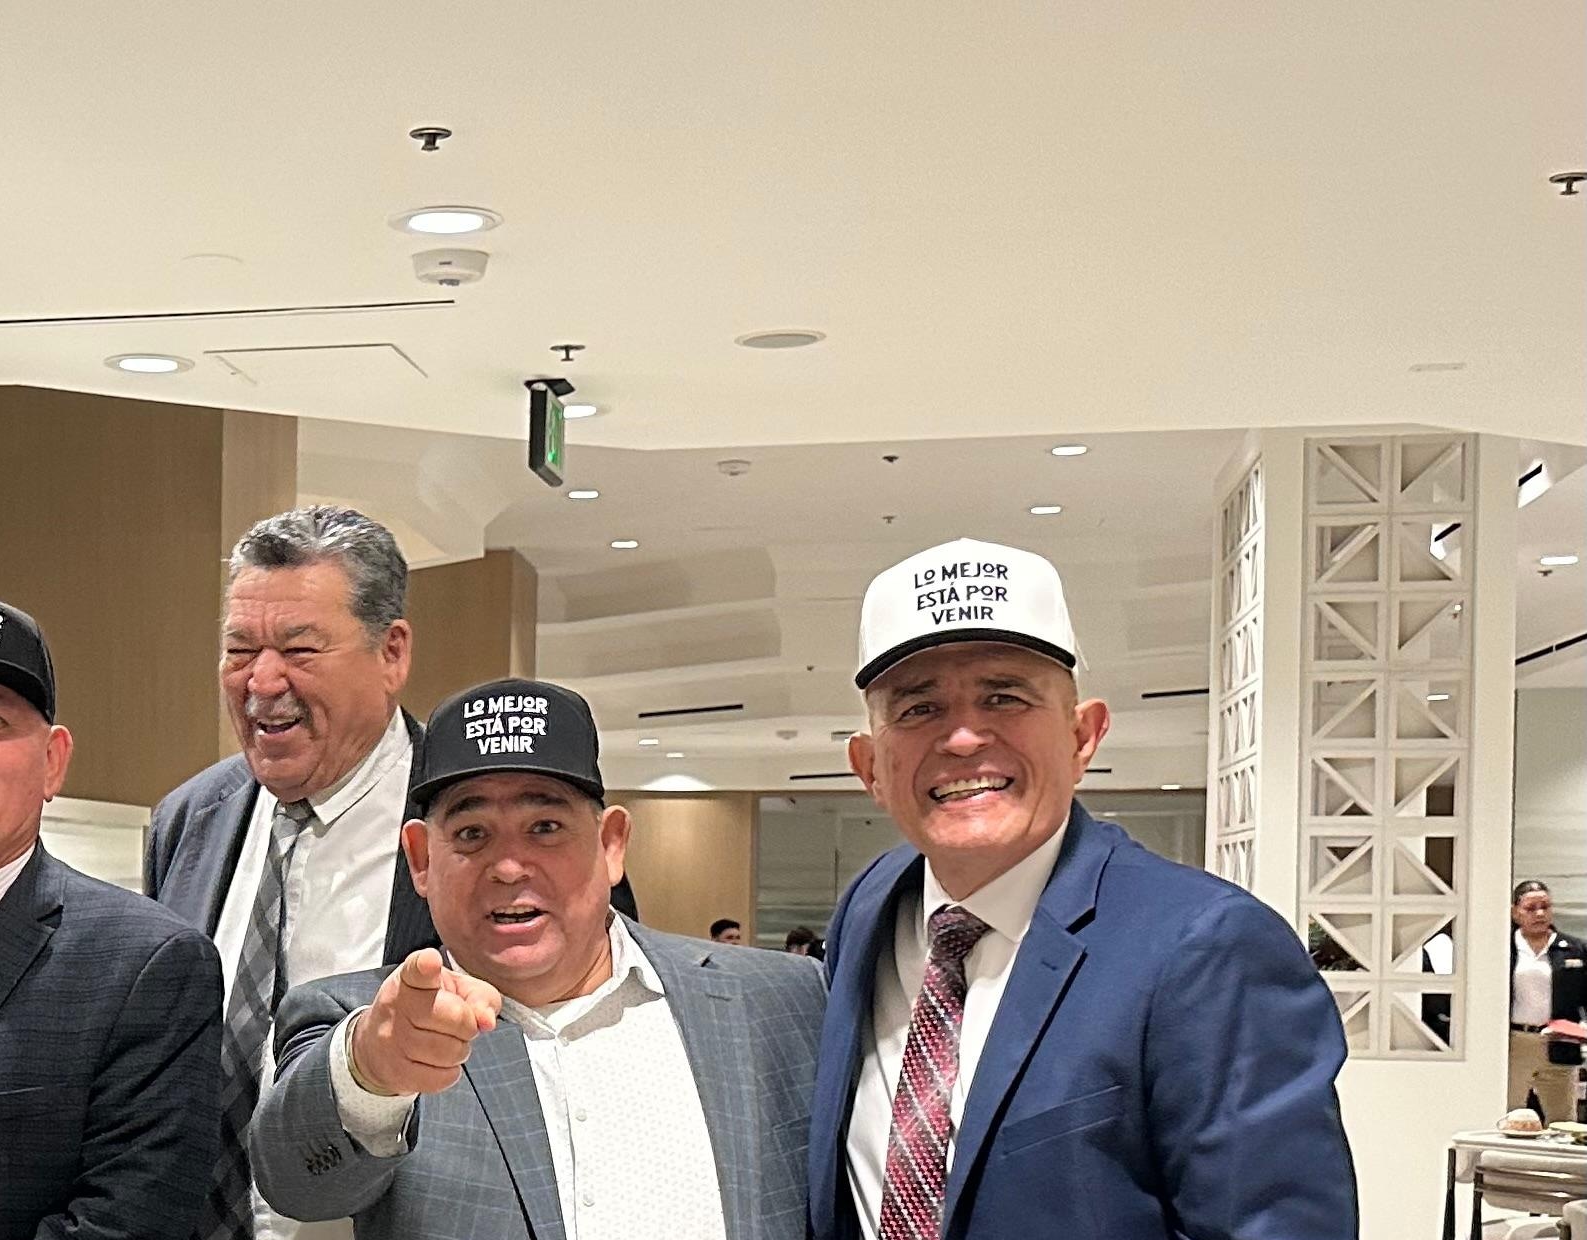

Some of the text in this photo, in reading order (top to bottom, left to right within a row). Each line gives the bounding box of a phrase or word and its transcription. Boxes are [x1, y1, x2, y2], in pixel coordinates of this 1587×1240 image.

[914, 562, 1008, 589] LO MEJOR
[916, 582, 1008, 610] ESTÁ POR
[931, 605, 994, 625] VENIR
[463, 695, 548, 718] LO MEJOR
[465, 712, 546, 739] ESTÁ POR
[477, 735, 534, 755] VENIR
